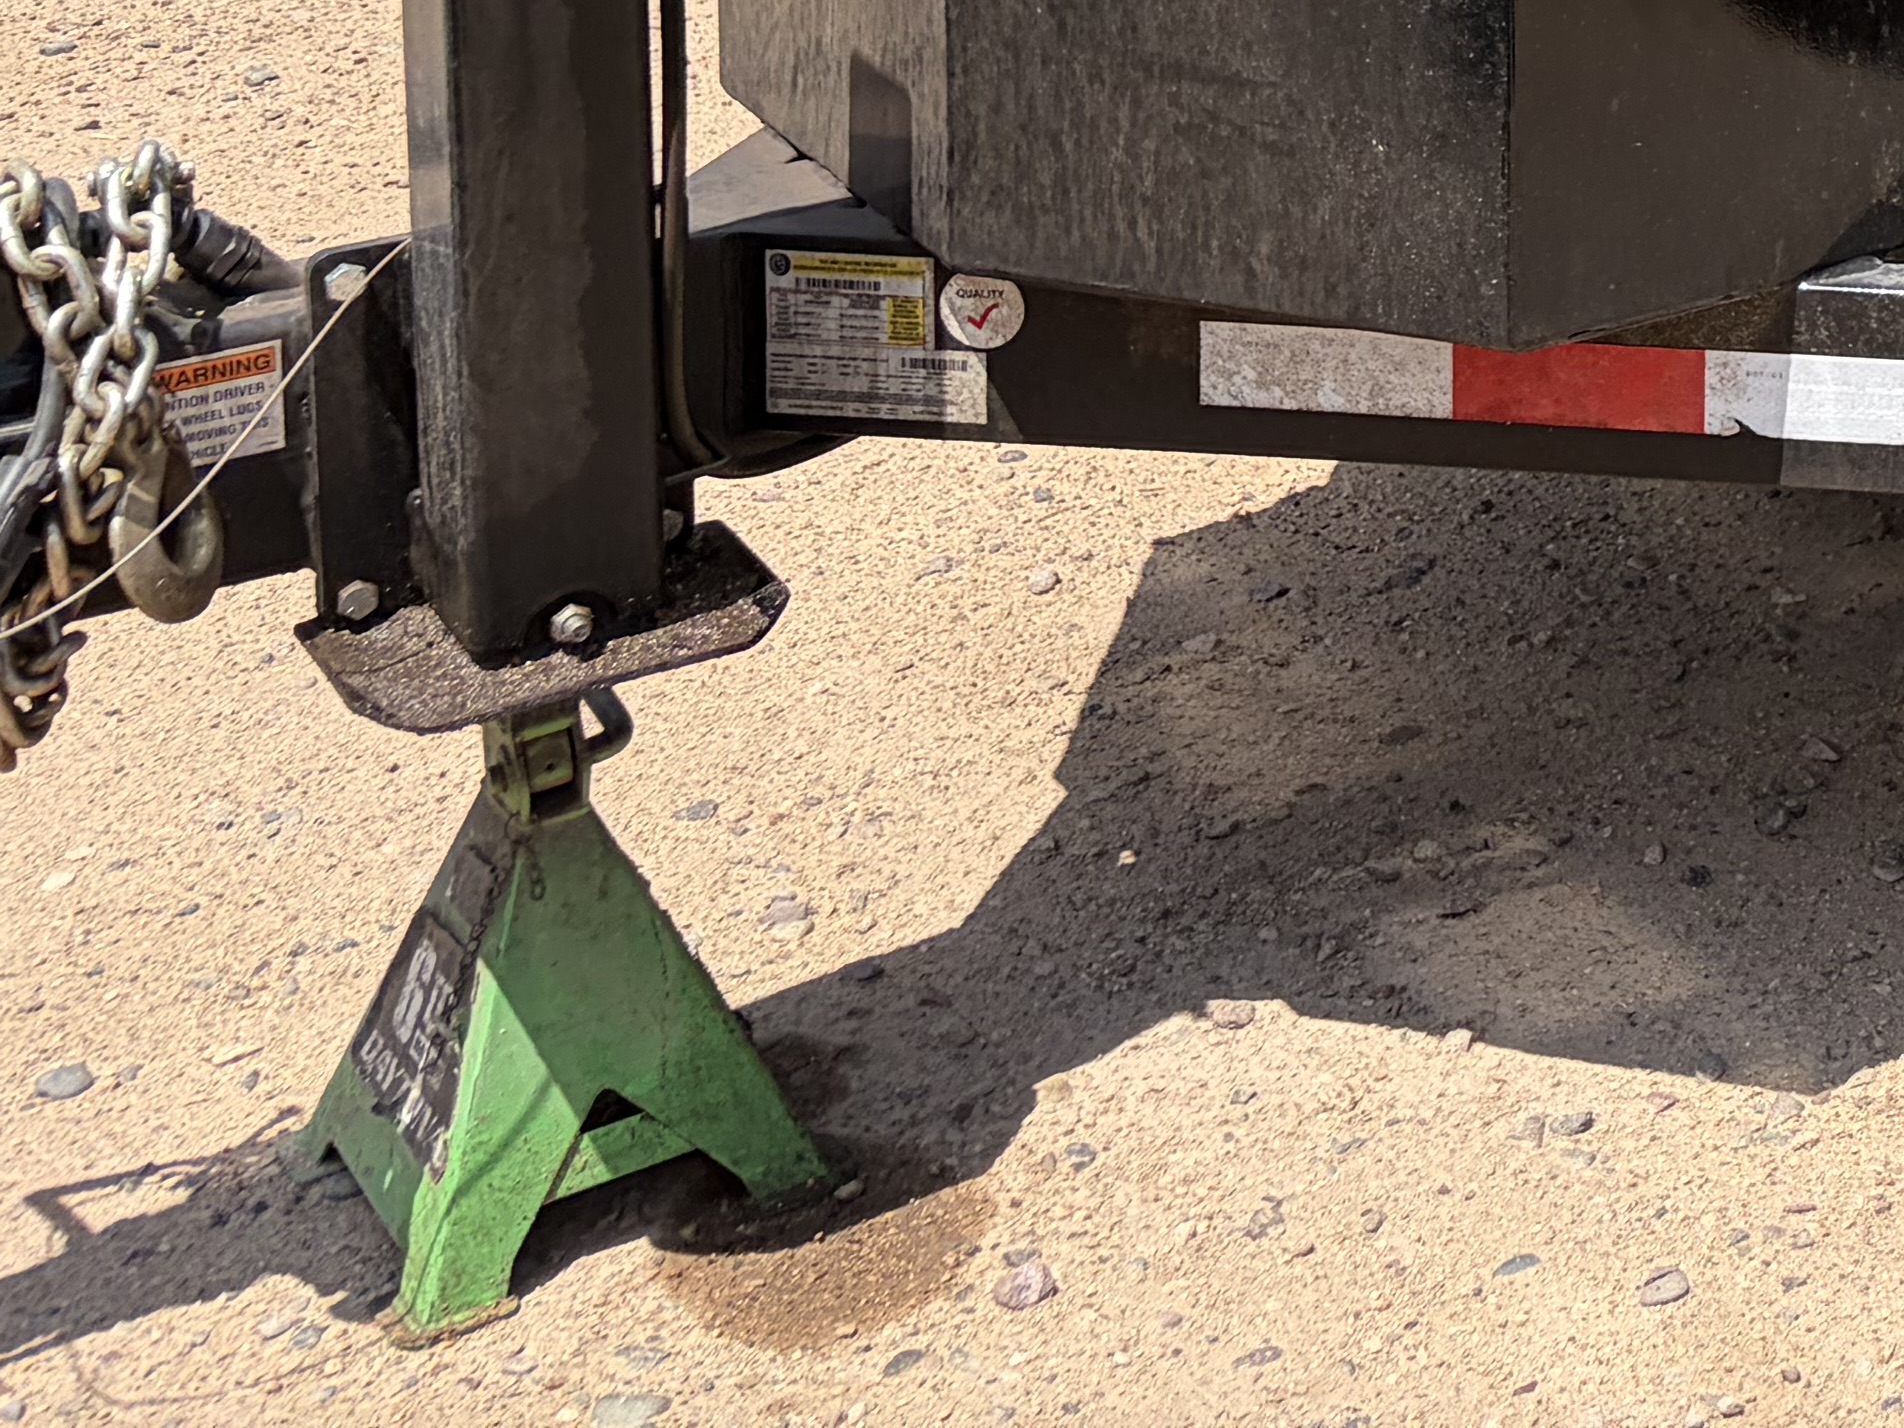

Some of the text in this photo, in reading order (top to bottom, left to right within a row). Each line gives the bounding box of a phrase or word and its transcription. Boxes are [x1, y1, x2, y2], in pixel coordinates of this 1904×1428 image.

[955, 288, 1005, 300] QUALITY
[158, 353, 271, 390] WARNING
[213, 381, 265, 404] DRIVER
[182, 399, 263, 427] WHEEL LUGS
[184, 423, 236, 443] MOVING
